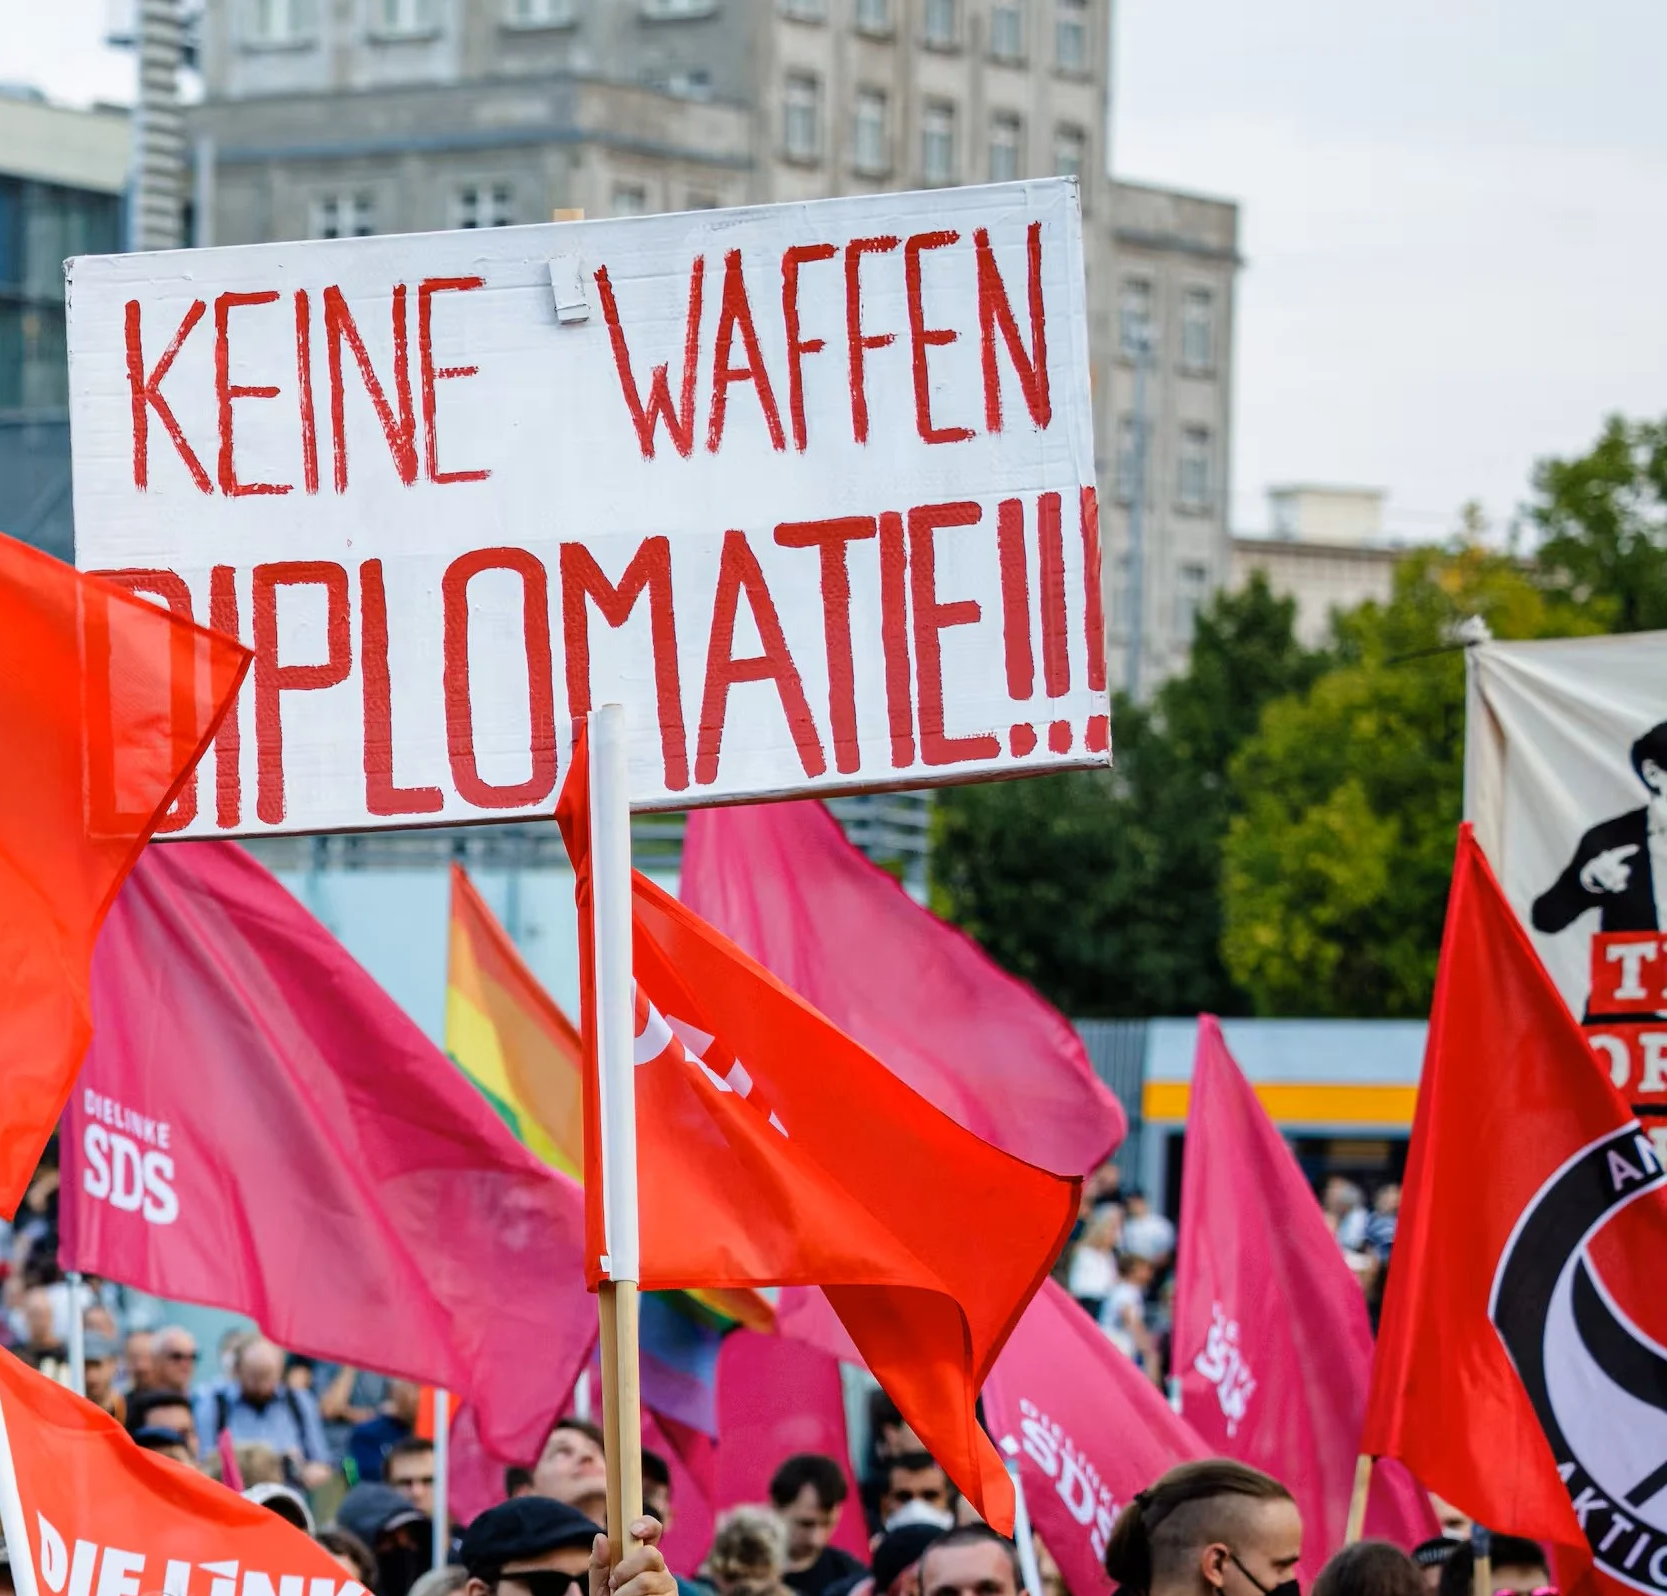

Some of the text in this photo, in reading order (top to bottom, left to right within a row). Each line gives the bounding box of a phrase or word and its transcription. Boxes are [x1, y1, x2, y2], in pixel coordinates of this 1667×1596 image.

[125, 222, 1053, 497] KEINE WAFFEN
[83, 1123, 179, 1225] SDS
